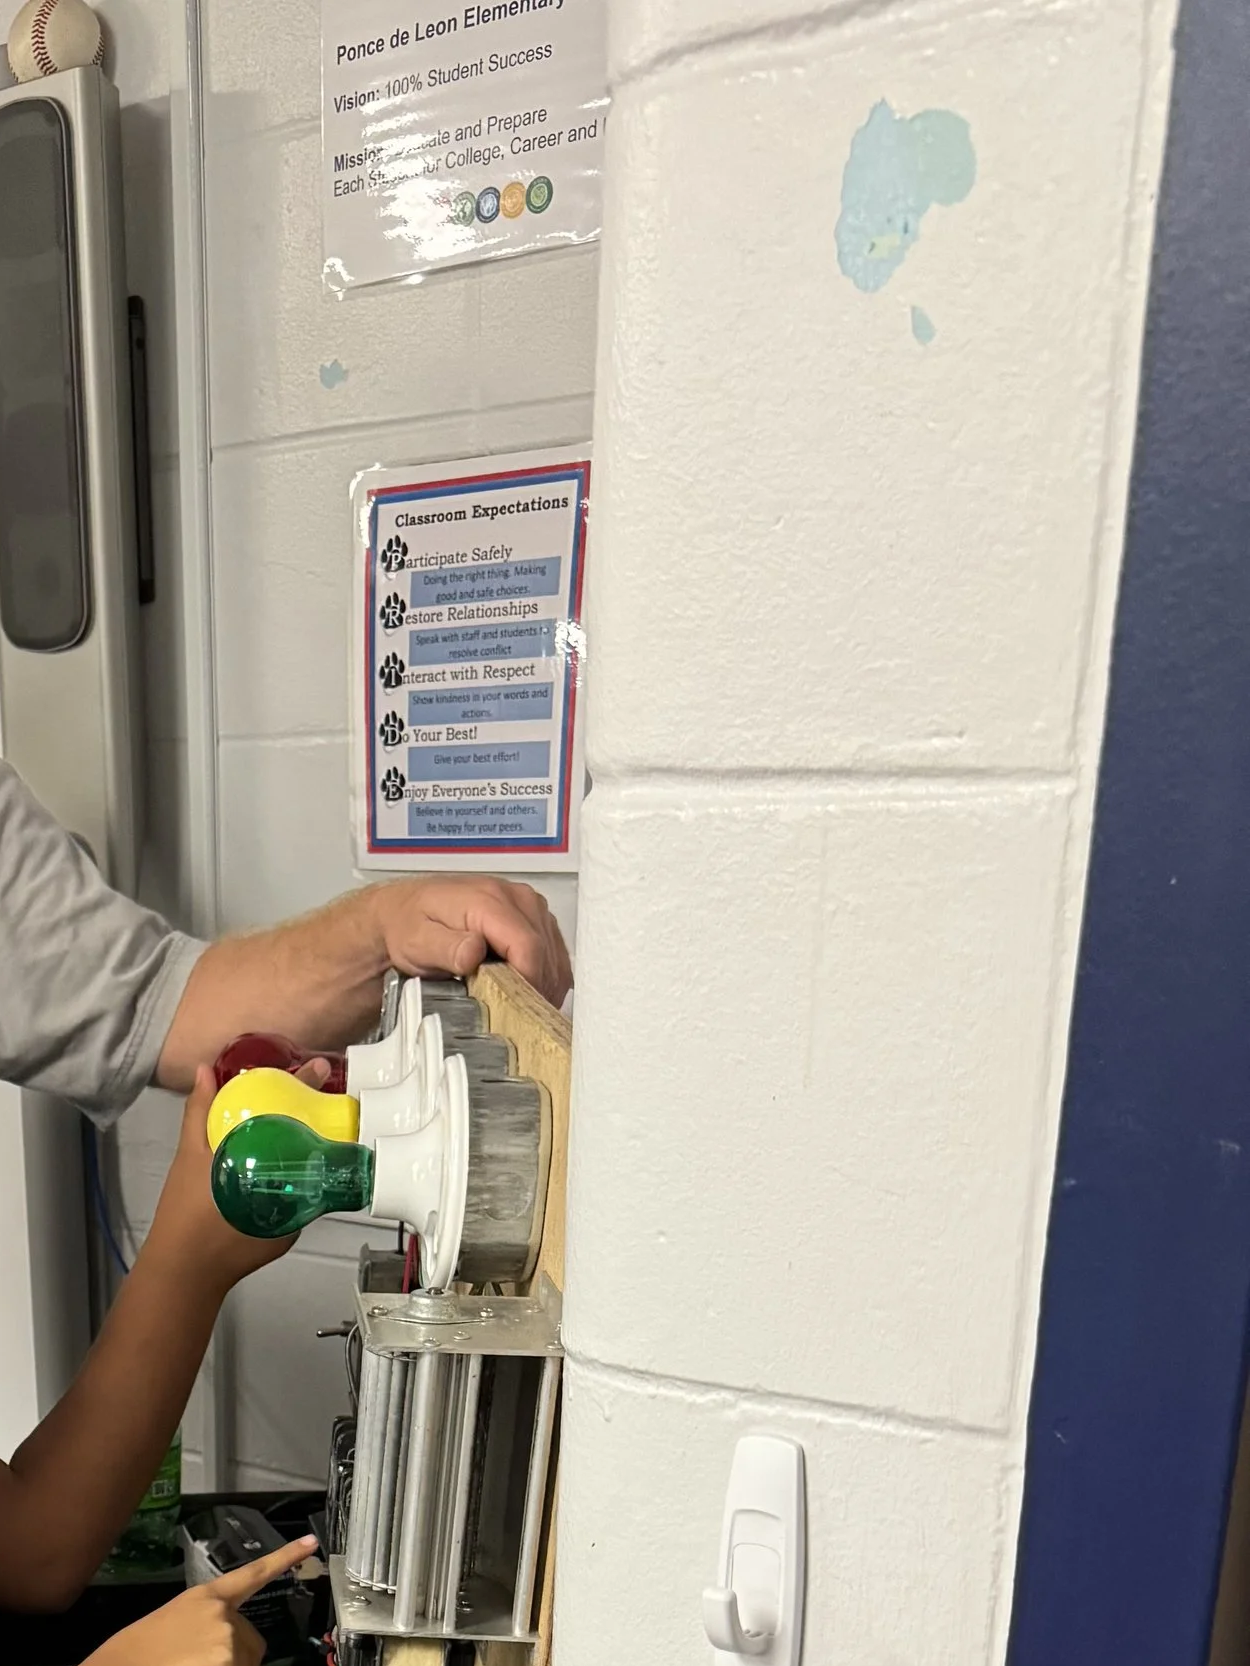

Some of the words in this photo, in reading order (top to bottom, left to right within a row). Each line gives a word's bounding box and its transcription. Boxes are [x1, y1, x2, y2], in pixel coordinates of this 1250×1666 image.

[336, 38, 385, 65] Ponce
[390, 27, 410, 49] de
[415, 16, 458, 42] Leon
[334, 88, 381, 113] Vision:
[385, 73, 423, 99] 100%
[427, 58, 484, 88] Student
[488, 43, 553, 71] Success
[455, 119, 482, 141] and
[487, 107, 548, 135] Prepare
[334, 175, 365, 197] Each
[445, 143, 505, 170] College,
[510, 130, 563, 156] Career
[568, 119, 597, 142] and
[395, 508, 466, 528] Classroom
[472, 496, 569, 520] Expectations
[392, 551, 468, 571] Participate
[472, 544, 512, 563] Safely
[424, 573, 447, 586] Doing
[450, 571, 463, 582] the
[465, 568, 485, 582] right
[514, 564, 547, 577] Making
[436, 590, 457, 604] good
[459, 587, 475, 599] and
[476, 585, 494, 598] safe
[496, 584, 531, 597] choices.
[388, 608, 443, 627] Restore
[448, 602, 539, 621] Relationships
[416, 633, 439, 646] Speak
[442, 630, 460, 643] with
[461, 628, 480, 641] staff
[481, 627, 498, 640] and
[500, 625, 537, 638] students
[449, 647, 478, 660] resolve
[480, 645, 512, 657] conflict
[390, 667, 447, 686] Interact
[450, 666, 478, 681] with
[483, 664, 535, 680] Respect
[412, 694, 434, 705] Show
[435, 691, 471, 704] kindness
[473, 691, 481, 702] in
[482, 691, 501, 704] your
[503, 689, 529, 700] words
[532, 687, 548, 699] and
[386, 727, 410, 745] Do
[413, 727, 443, 742] Your
[446, 726, 478, 741] Best!
[434, 753, 452, 765] Give
[453, 753, 471, 767] your
[473, 752, 491, 764] best
[493, 751, 520, 763] effort!
[389, 782, 428, 801] Enjoy
[432, 782, 496, 800] Everyone's
[500, 781, 553, 796] Success
[416, 805, 443, 818] Believe
[446, 805, 454, 817] in
[455, 804, 488, 819] yourself
[490, 804, 506, 816] and
[508, 803, 538, 815] others.
[427, 822, 436, 833] Be
[438, 821, 462, 835] happy
[464, 821, 477, 832] for
[478, 822, 497, 835] your
